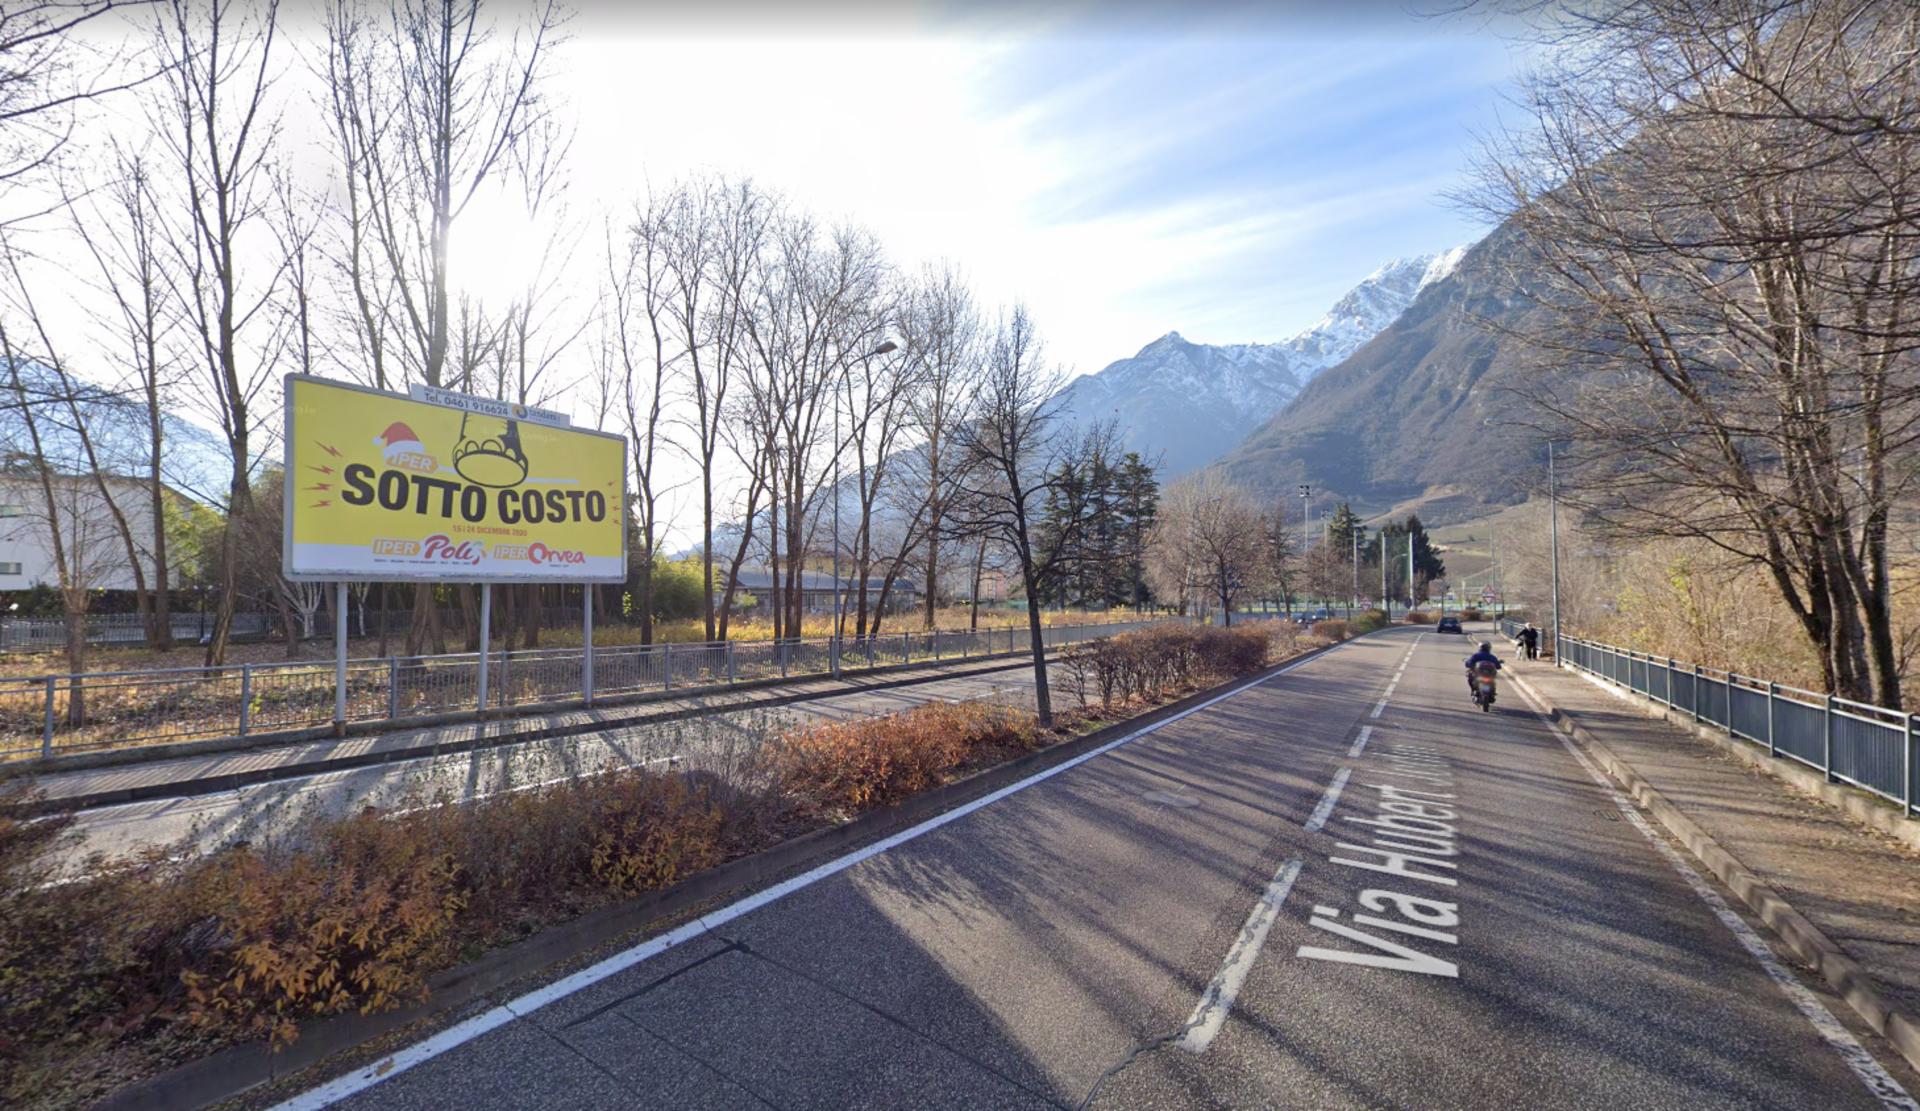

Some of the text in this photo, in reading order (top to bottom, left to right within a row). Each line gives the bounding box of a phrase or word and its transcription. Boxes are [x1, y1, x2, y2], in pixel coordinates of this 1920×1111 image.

[424, 392, 442, 404] Tel.
[444, 396, 468, 409] 0461
[472, 402, 509, 416] 916624
[391, 453, 433, 471] IPER
[341, 463, 606, 524] SOTTO COSTO
[374, 534, 474, 560] IPER Poli
[527, 542, 586, 565] Orvea
